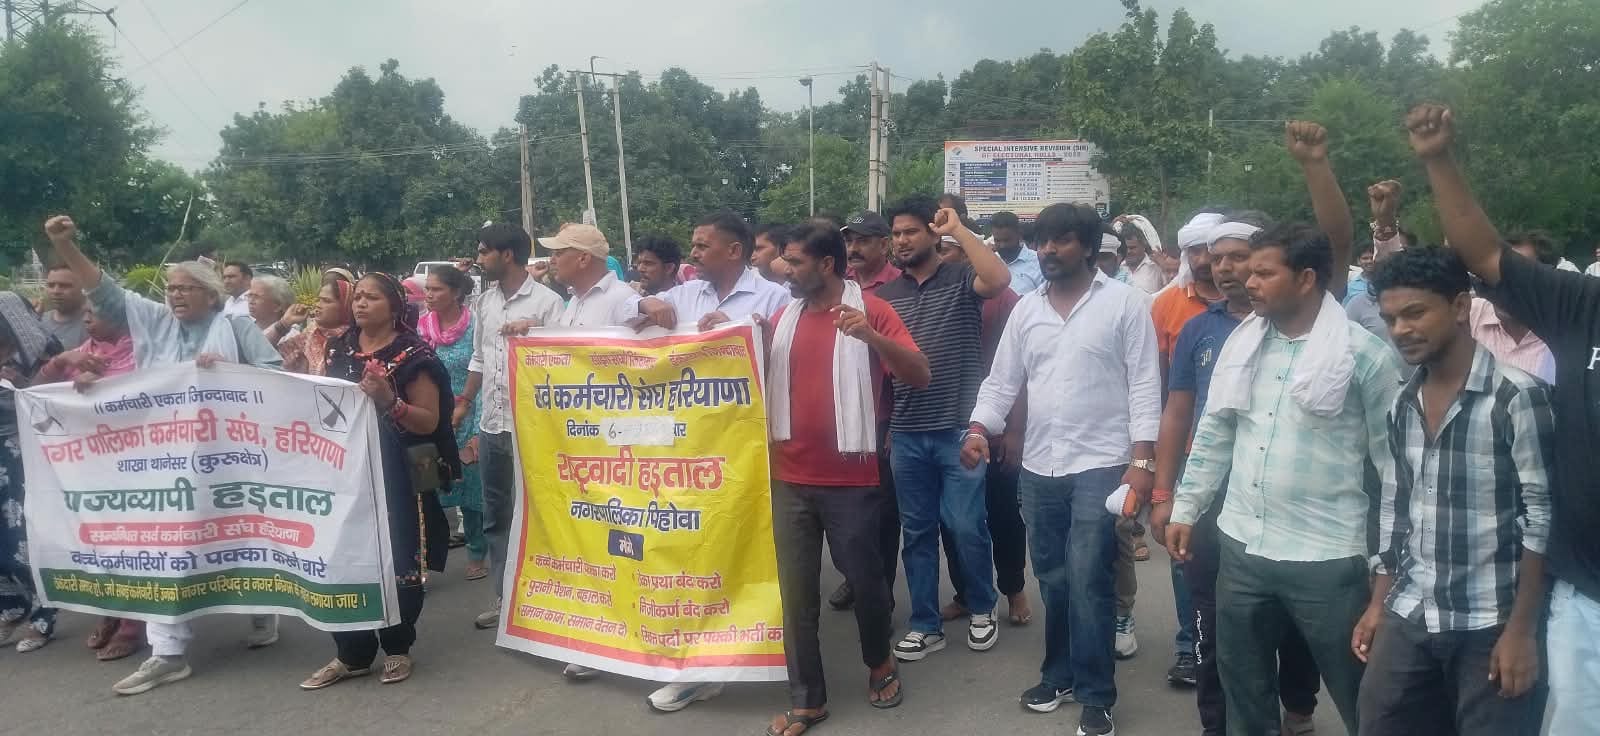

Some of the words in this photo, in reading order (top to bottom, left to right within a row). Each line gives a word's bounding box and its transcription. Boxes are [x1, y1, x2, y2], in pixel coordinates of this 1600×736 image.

[553, 372, 633, 410] कर्मचारी
[668, 367, 751, 411] हरियाणा
[104, 391, 152, 413] कर्मचारी
[152, 389, 185, 407] एकता
[566, 419, 600, 437] दिनांक
[86, 423, 145, 455] पालिका
[148, 408, 218, 446] कर्मचारी
[225, 411, 266, 448] संघ,
[274, 420, 347, 471] हरियाणा
[117, 456, 147, 473] शाखा
[151, 452, 187, 471] थानेसर
[645, 500, 701, 531] पिहोवा
[160, 521, 218, 543] कर्मचारी
[257, 521, 301, 543] हरियाणा
[100, 550, 167, 571] कर्मचारियों
[170, 551, 198, 571] को
[205, 547, 269, 565] पक्का
[600, 563, 616, 581] करो
[696, 571, 721, 589] करो
[250, 577, 273, 592] नगर
[335, 593, 358, 609] जाए
[526, 578, 554, 597] पुरानी
[682, 599, 701, 618] बंद
[703, 598, 730, 616] करो
